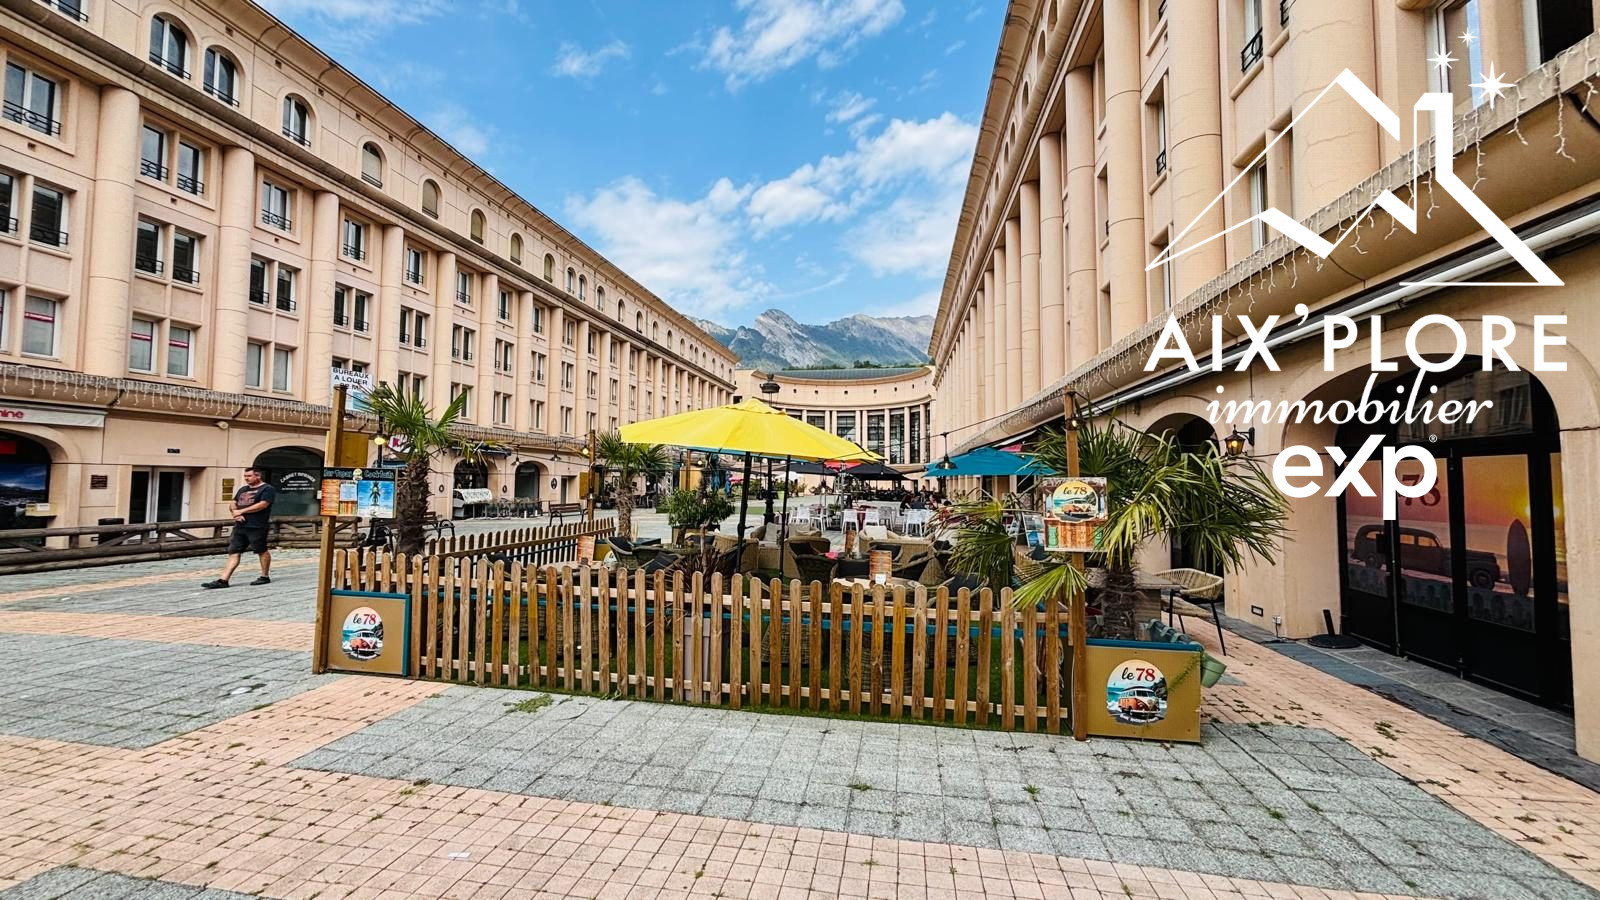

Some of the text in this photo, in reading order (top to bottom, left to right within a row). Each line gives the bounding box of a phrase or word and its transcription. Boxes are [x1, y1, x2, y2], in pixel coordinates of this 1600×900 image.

[332, 367, 369, 380] BUREAUX
[342, 376, 368, 386] LOUER
[1073, 486, 1088, 495] 78
[352, 613, 377, 625] le 78
[1121, 667, 1156, 682] le 78
